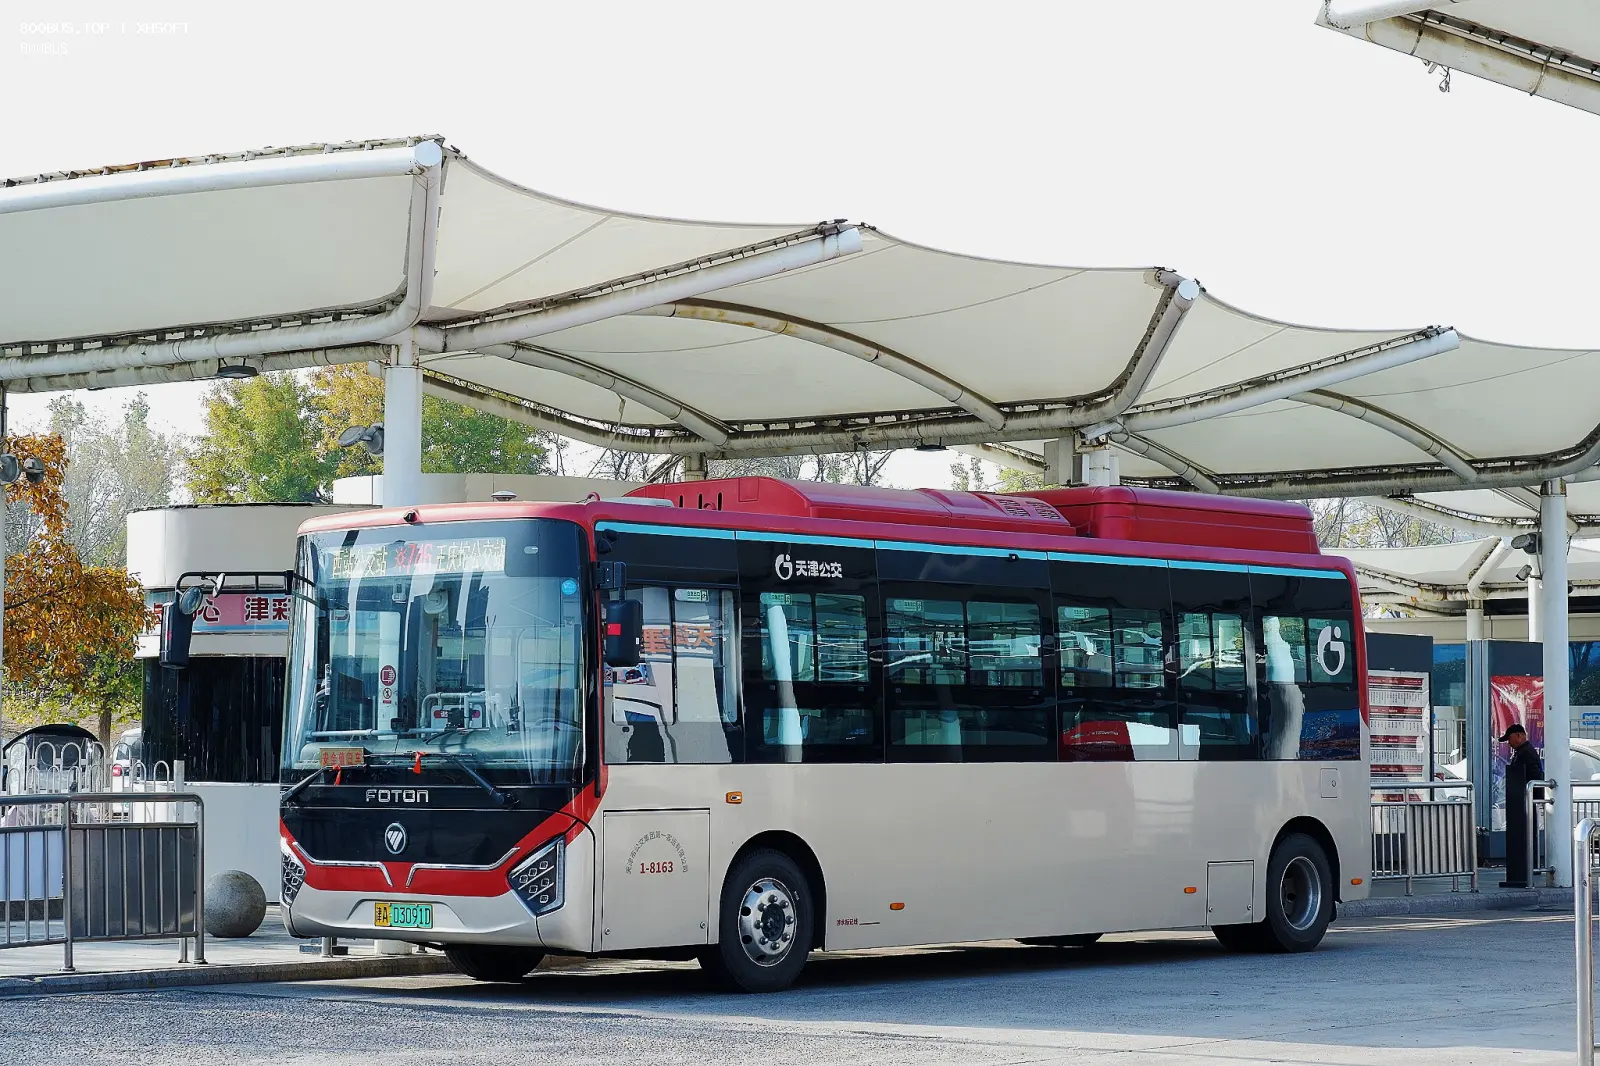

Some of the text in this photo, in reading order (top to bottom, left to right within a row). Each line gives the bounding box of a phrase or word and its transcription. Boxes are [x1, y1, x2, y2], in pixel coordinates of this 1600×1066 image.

[795, 560, 843, 579] 天津公交
[365, 789, 429, 803] FOTON
[640, 861, 674, 874] 1-8163
